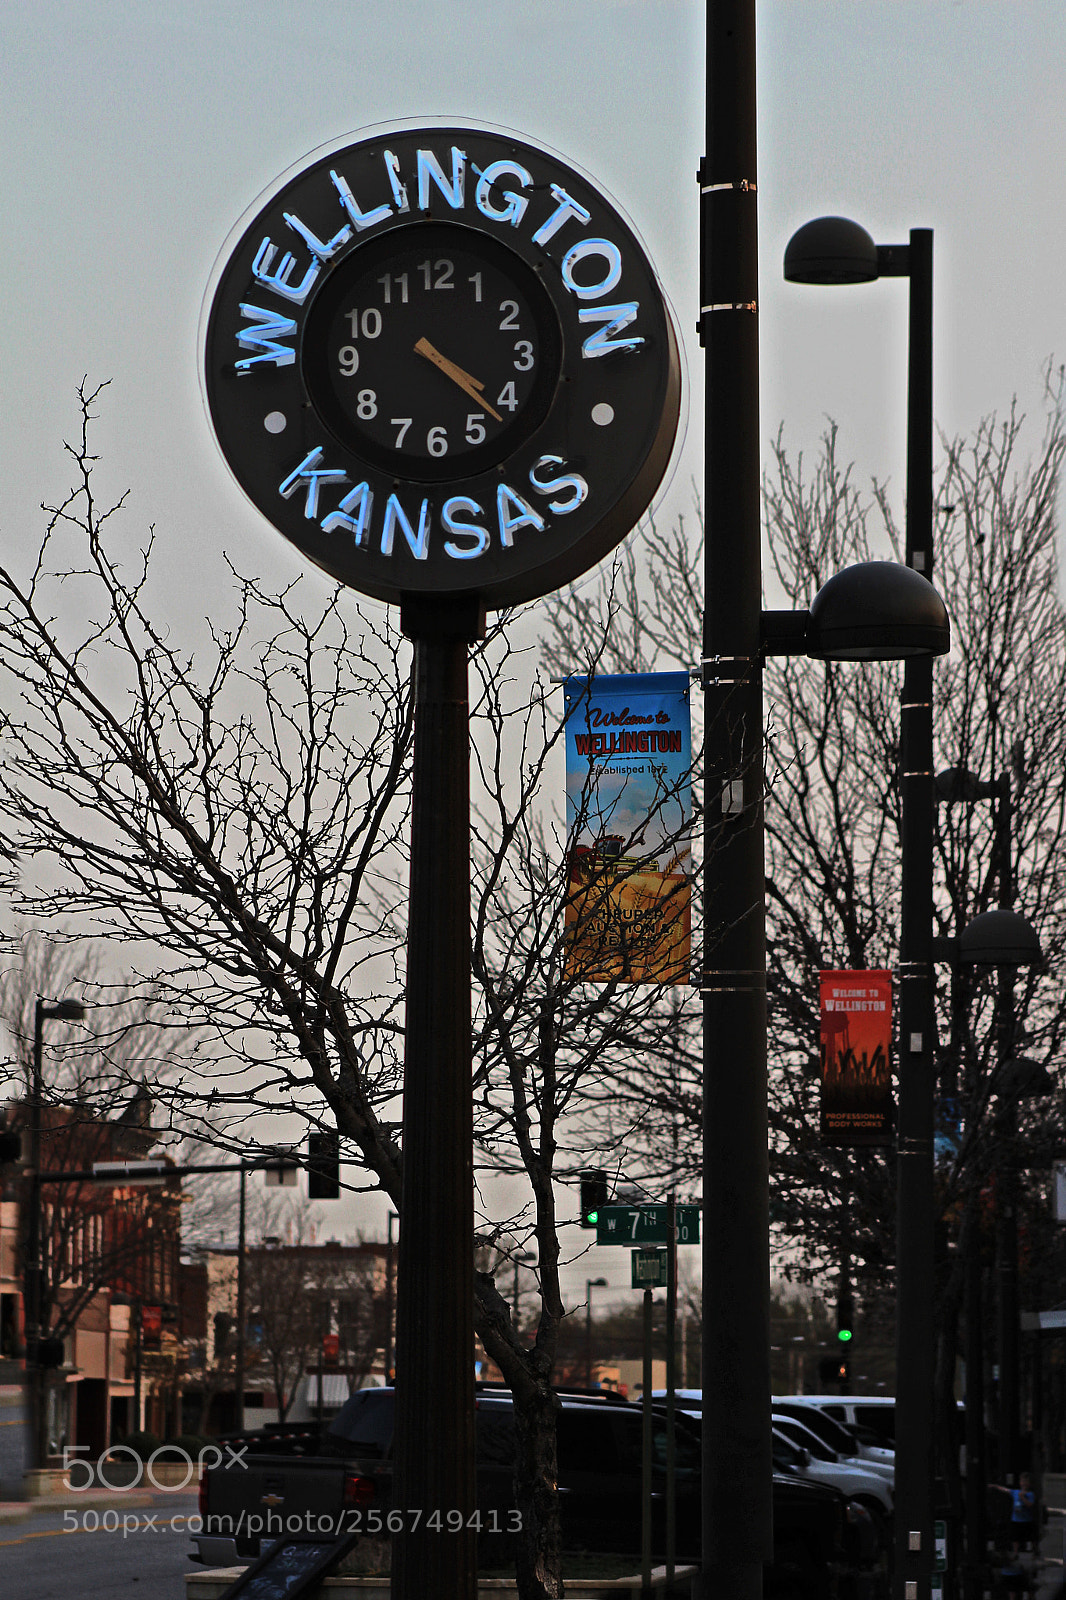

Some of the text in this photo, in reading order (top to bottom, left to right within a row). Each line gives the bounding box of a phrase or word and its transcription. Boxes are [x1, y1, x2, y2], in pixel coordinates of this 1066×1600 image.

[234, 146, 646, 376] WELLINGTON
[417, 258, 455, 290] 12
[377, 273, 409, 303] 11
[468, 272, 482, 302] 1
[344, 308, 383, 339] 10
[499, 300, 520, 331] 2
[338, 345, 360, 376] 9
[513, 340, 535, 371] 3
[356, 389, 378, 420] 8
[497, 381, 518, 412] 4
[390, 418, 413, 448] 7
[426, 426, 448, 457] 6
[465, 413, 486, 444] 5
[278, 446, 589, 560] KANSAS
[585, 707, 671, 727] Welcome to
[575, 730, 682, 755] WELLINGTON
[585, 922, 656, 934] AUCION
[825, 1000, 886, 1012] WELLINGTON
[825, 1112, 885, 1120] PROFESSIONAL
[828, 1120, 882, 1128] BODY WORKS
[607, 1218, 616, 1232] W
